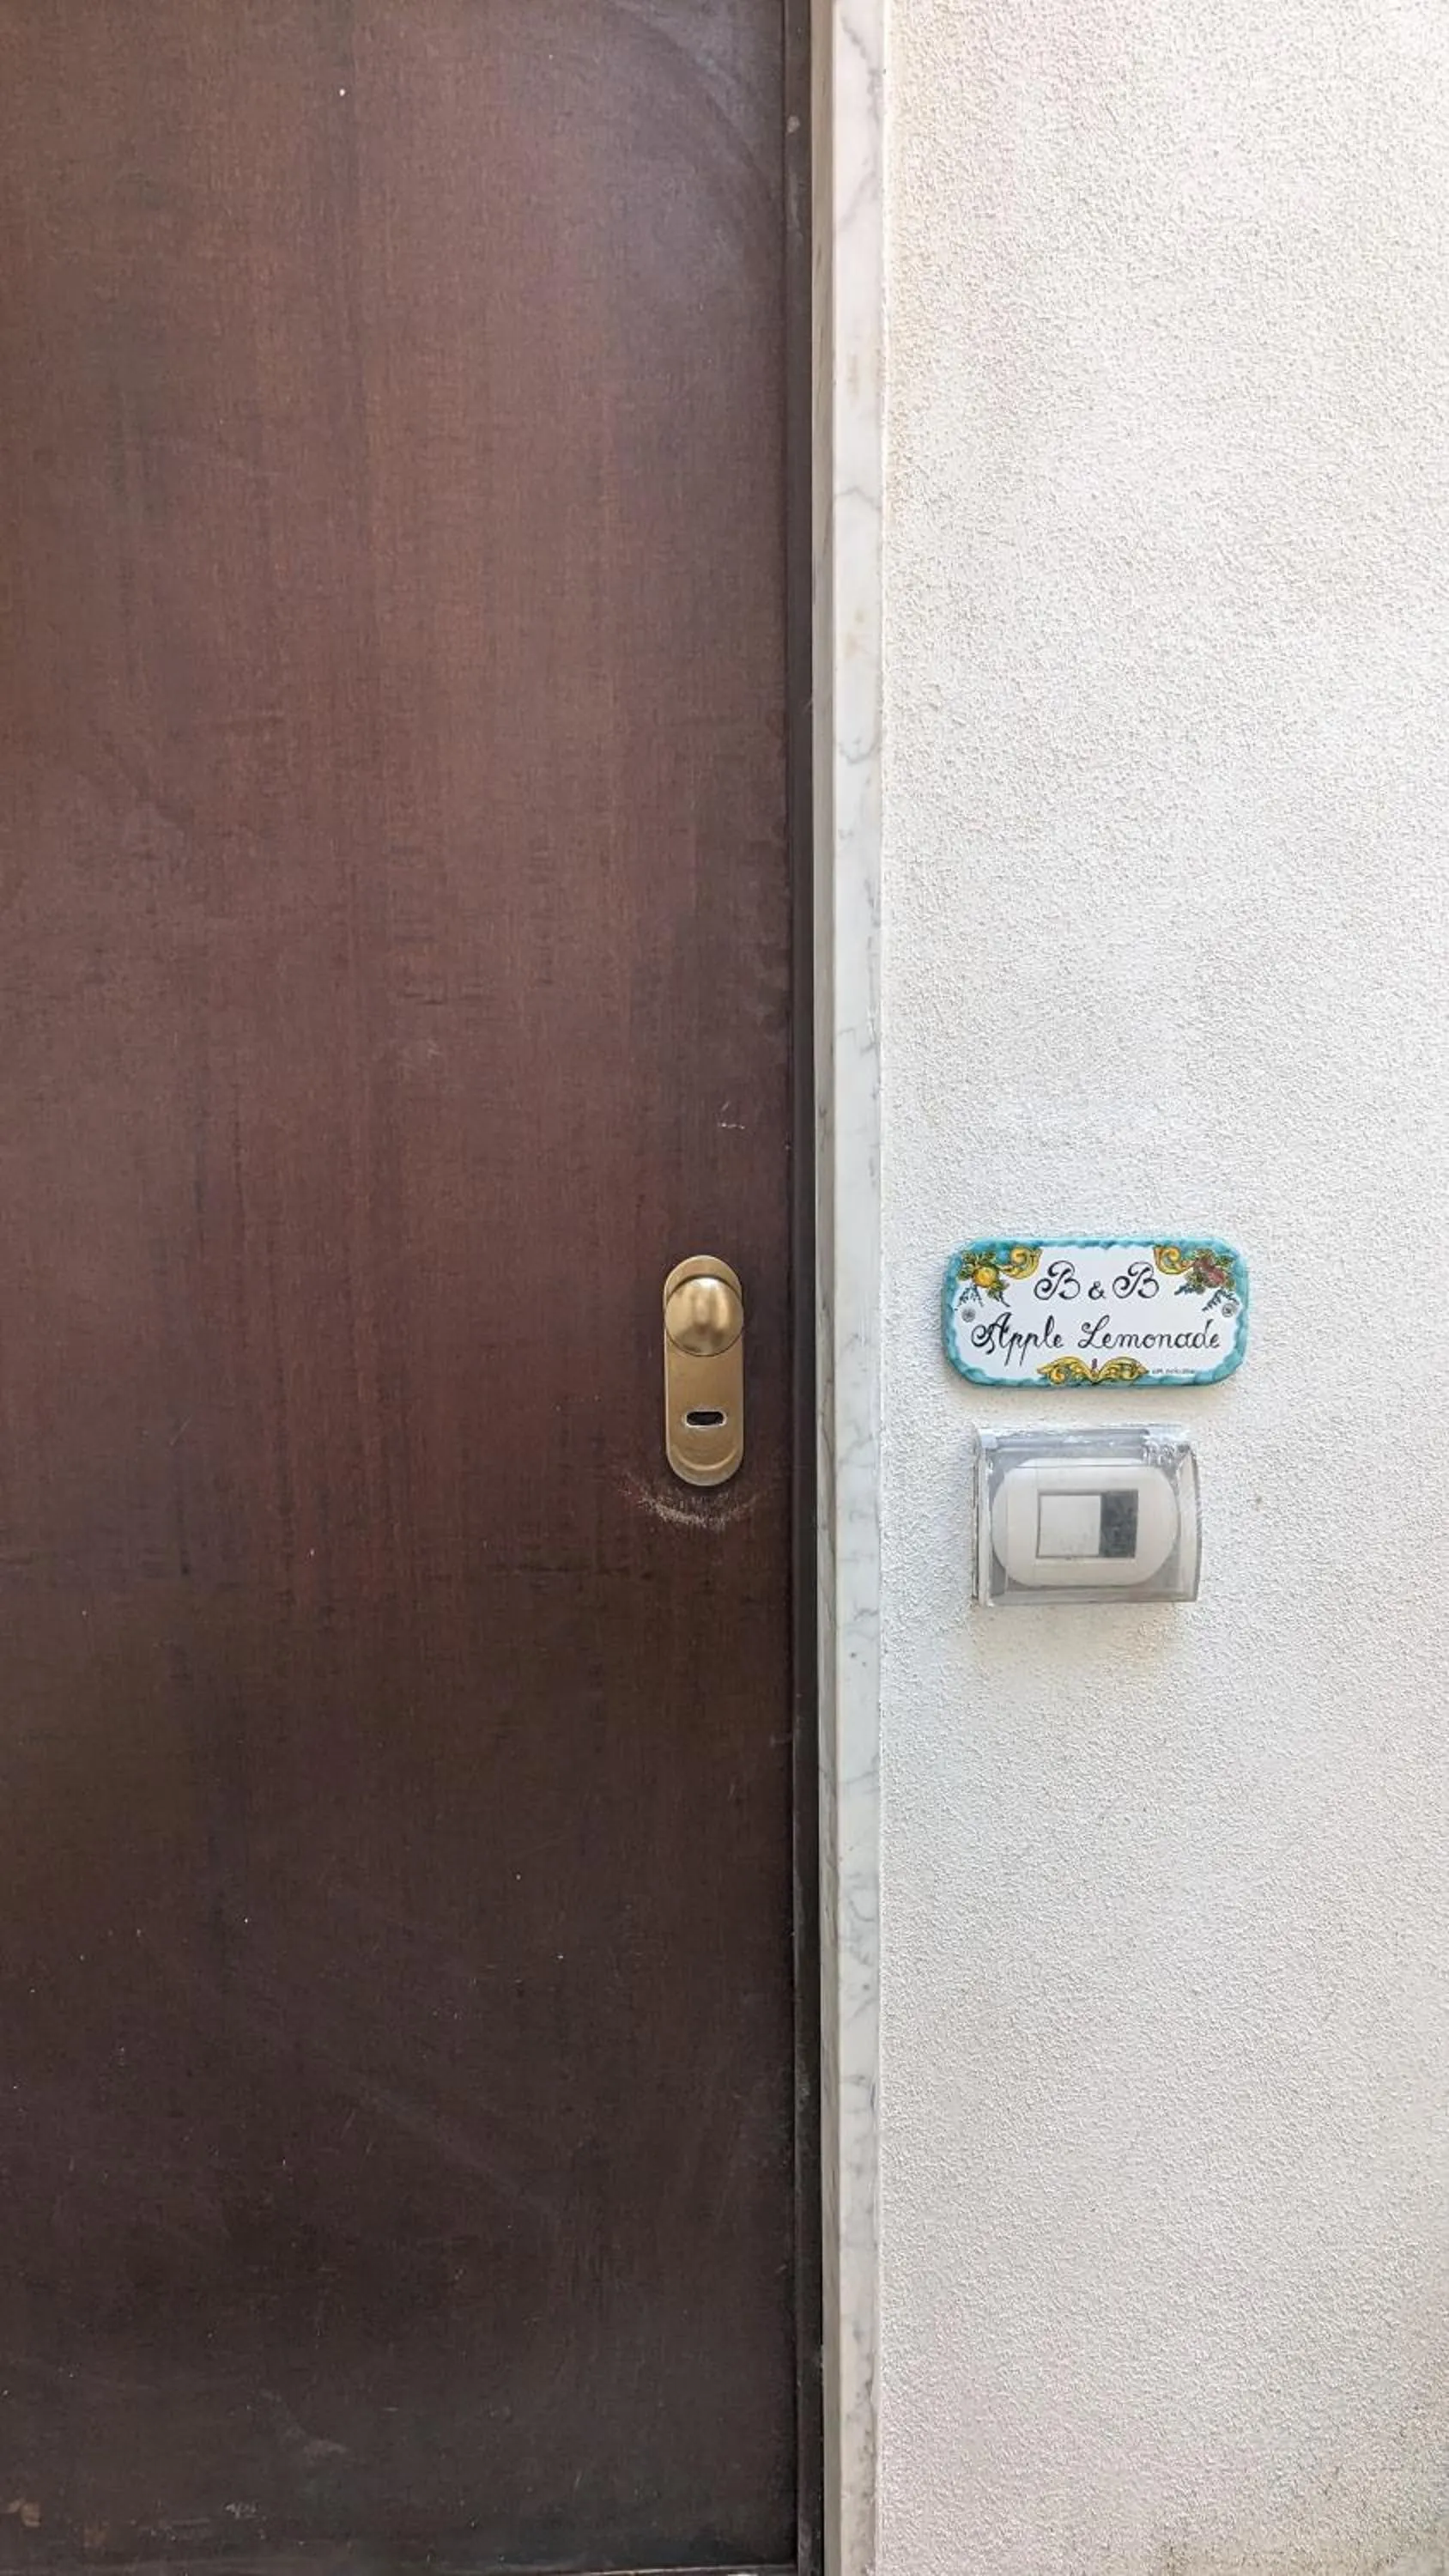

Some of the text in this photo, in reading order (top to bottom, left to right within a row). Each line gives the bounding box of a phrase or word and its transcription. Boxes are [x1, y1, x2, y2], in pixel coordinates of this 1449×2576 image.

[1034, 1260, 1160, 1301] B & B
[971, 1312, 1220, 1367] Apple Lemonade
